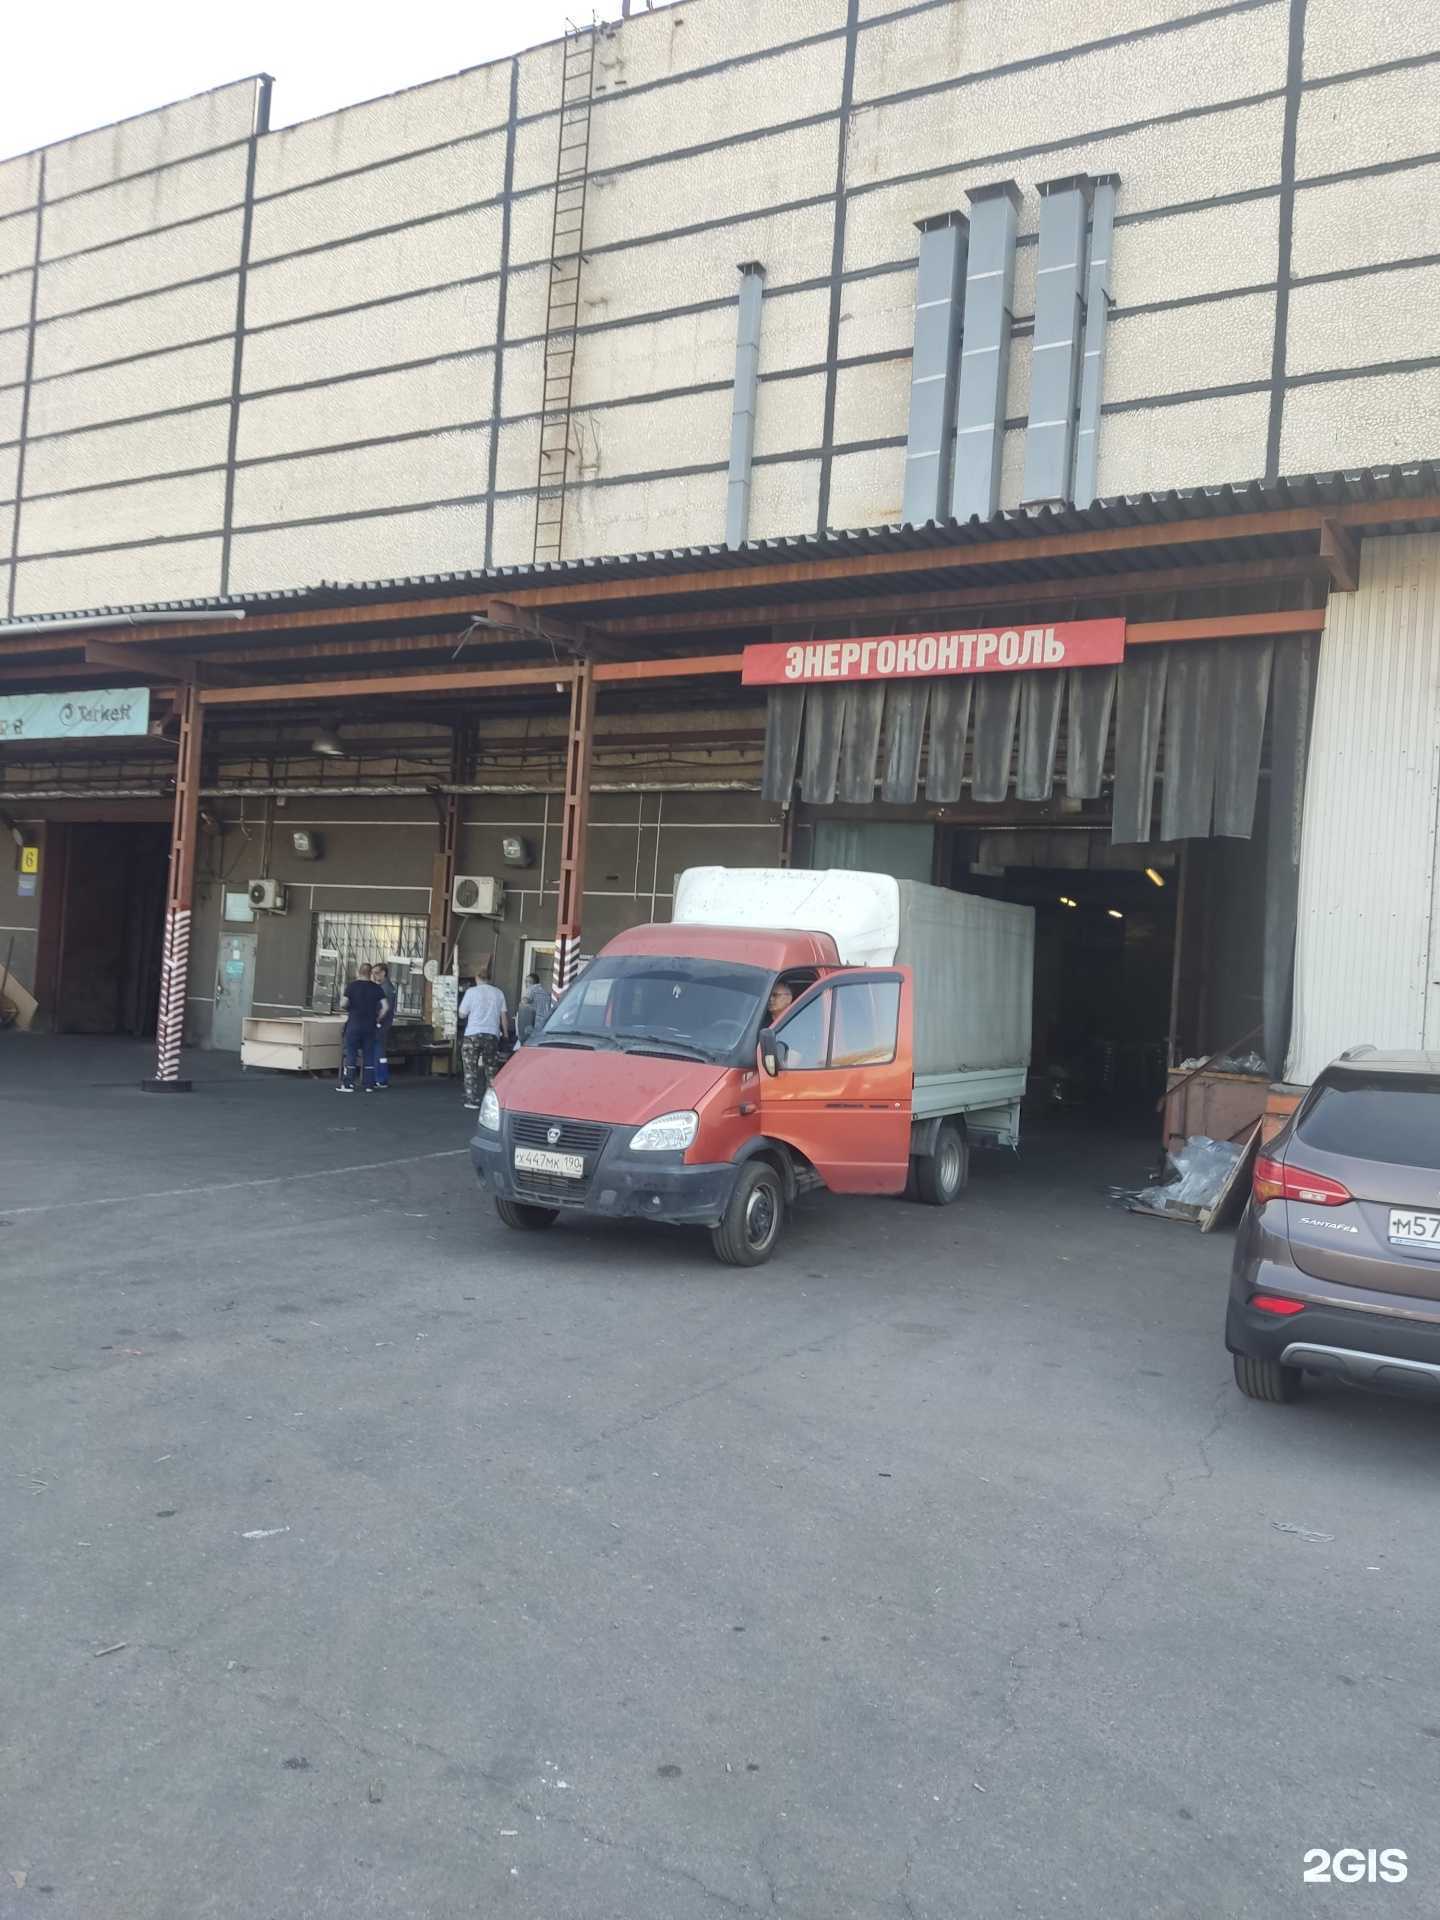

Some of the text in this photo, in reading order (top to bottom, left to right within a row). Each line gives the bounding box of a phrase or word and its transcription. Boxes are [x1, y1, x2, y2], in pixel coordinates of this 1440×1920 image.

[784, 627, 1066, 679] ЭНЕРГОКОНТРОЛЬ
[25, 851, 34, 867] 6
[565, 1156, 580, 1168] 190
